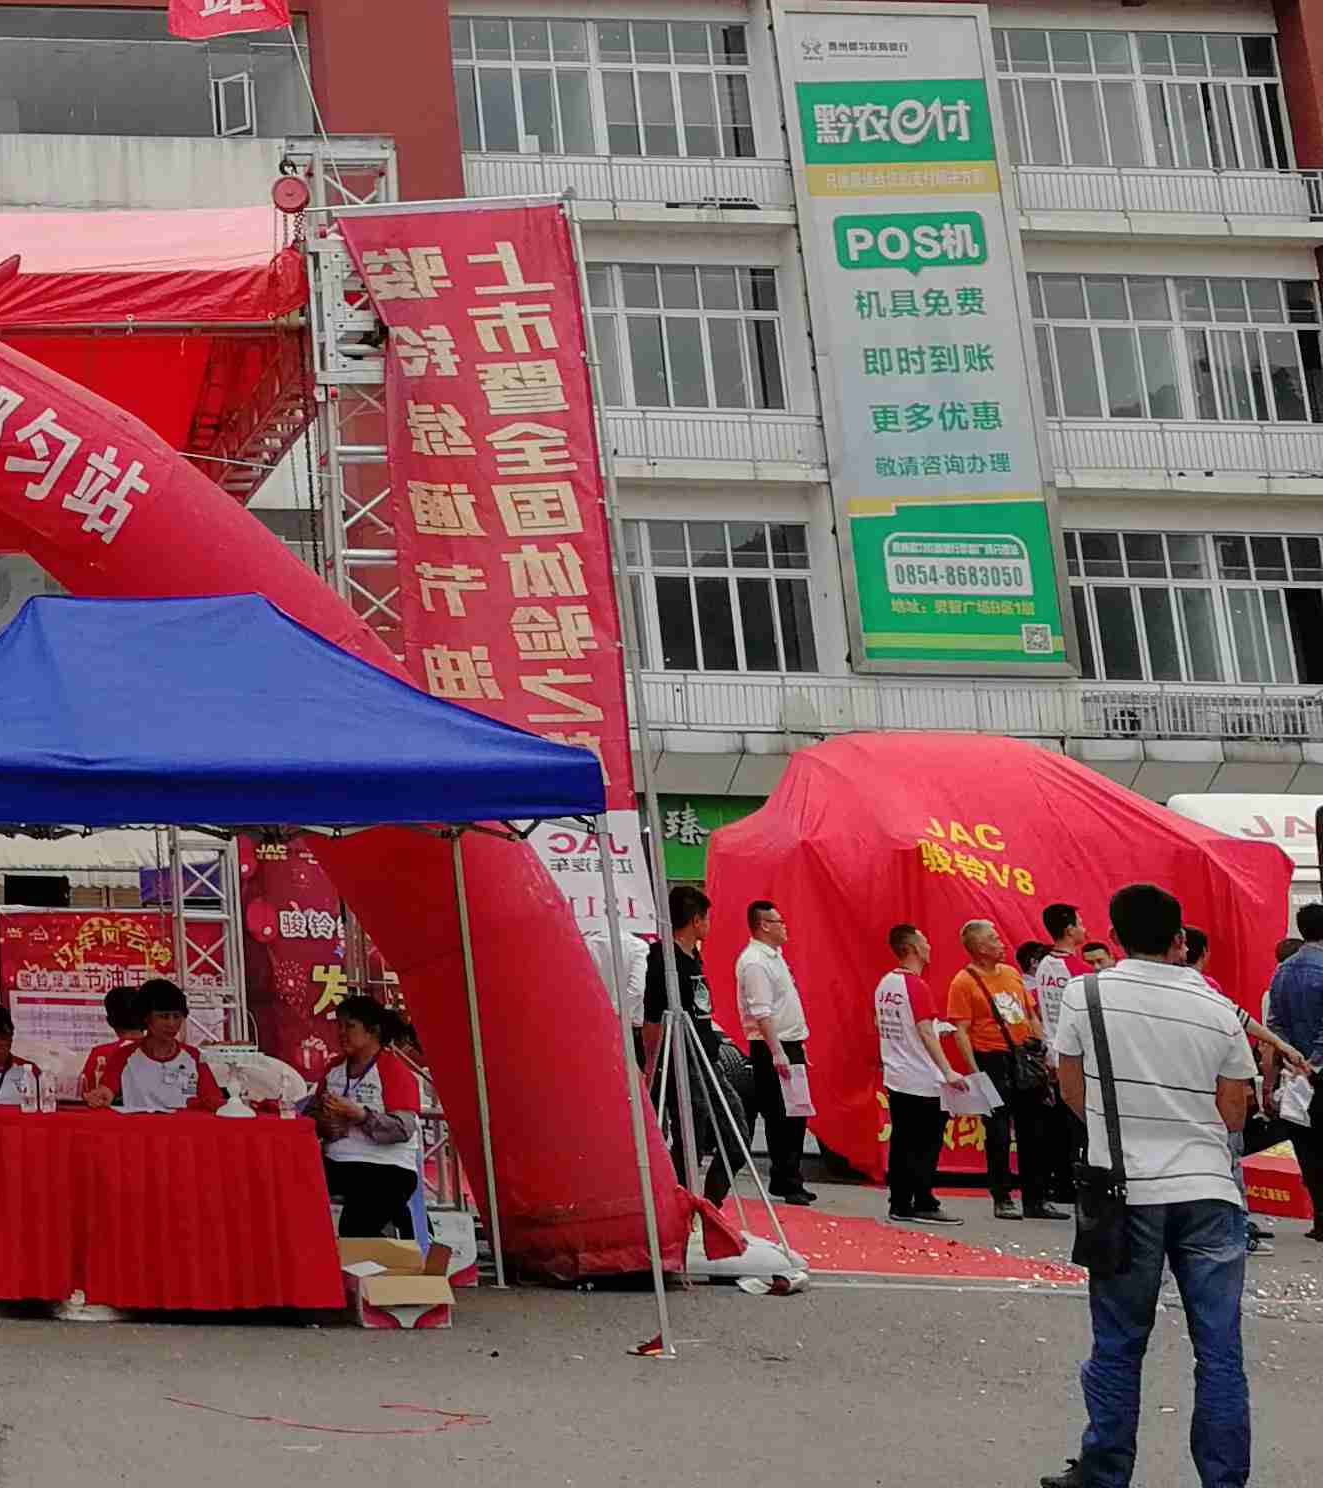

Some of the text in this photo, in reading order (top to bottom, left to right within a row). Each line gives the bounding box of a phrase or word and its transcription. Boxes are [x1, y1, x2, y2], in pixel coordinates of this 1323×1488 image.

[846, 222, 980, 262] POS机
[855, 286, 988, 319] 机具免费
[863, 343, 996, 377] 即时到账
[871, 400, 1004, 434] 更多优惠
[875, 452, 1012, 479] 敬请咨询办理
[894, 563, 1023, 587] 0854-8683050
[924, 816, 1005, 851] JAC
[878, 992, 904, 1005] JAC
